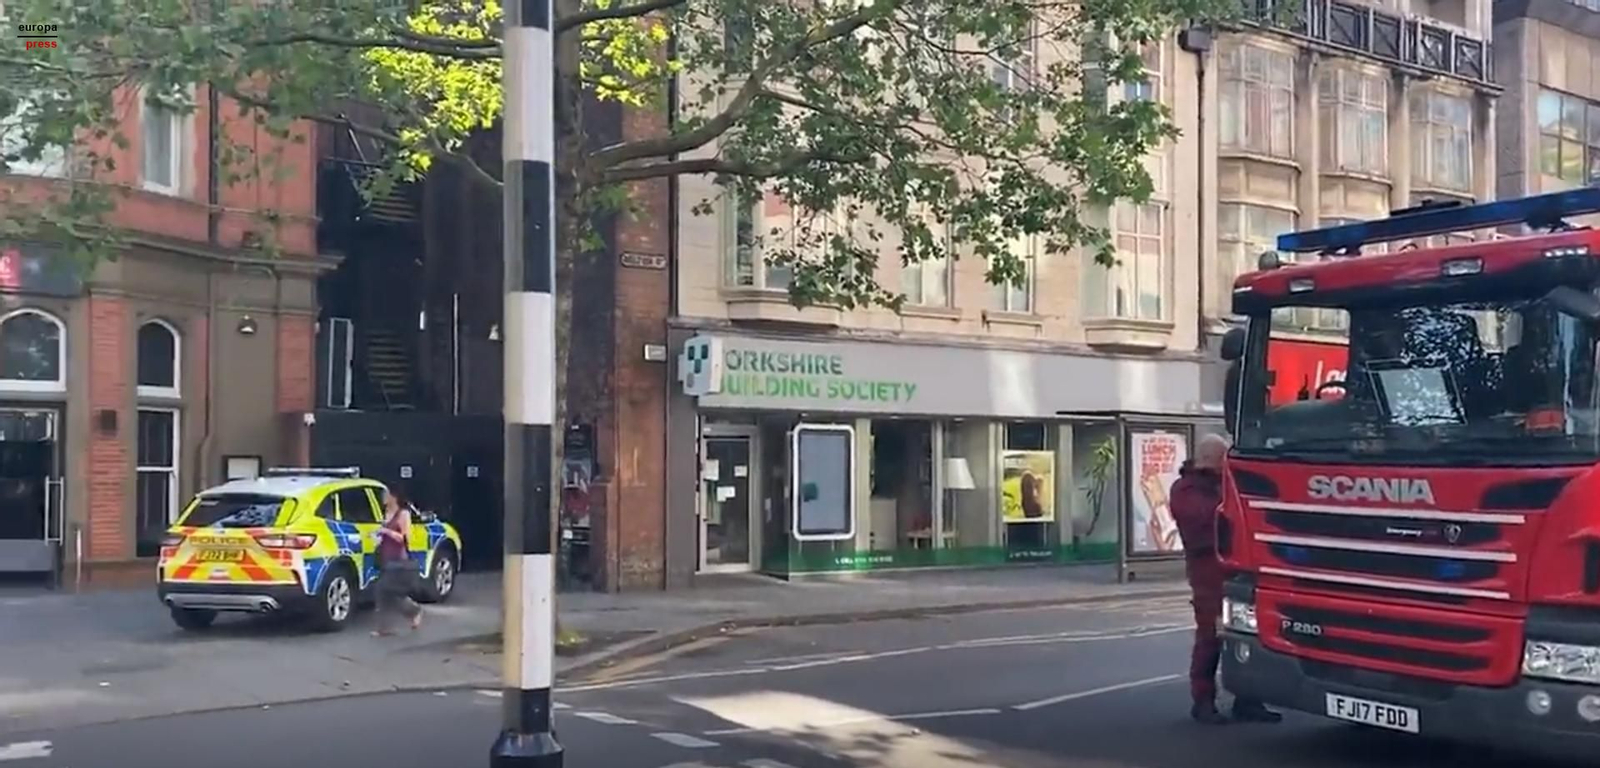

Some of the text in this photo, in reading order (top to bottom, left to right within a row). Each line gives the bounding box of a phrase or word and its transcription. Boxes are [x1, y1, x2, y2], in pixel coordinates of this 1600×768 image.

[725, 349, 844, 375] ORKSHIRE
[827, 381, 917, 401] SOCIETY
[1306, 475, 1436, 505] SCANIA
[189, 536, 249, 544] POLICE
[1282, 619, 1321, 636] P 280
[1335, 698, 1409, 728] FJ17 FDD
